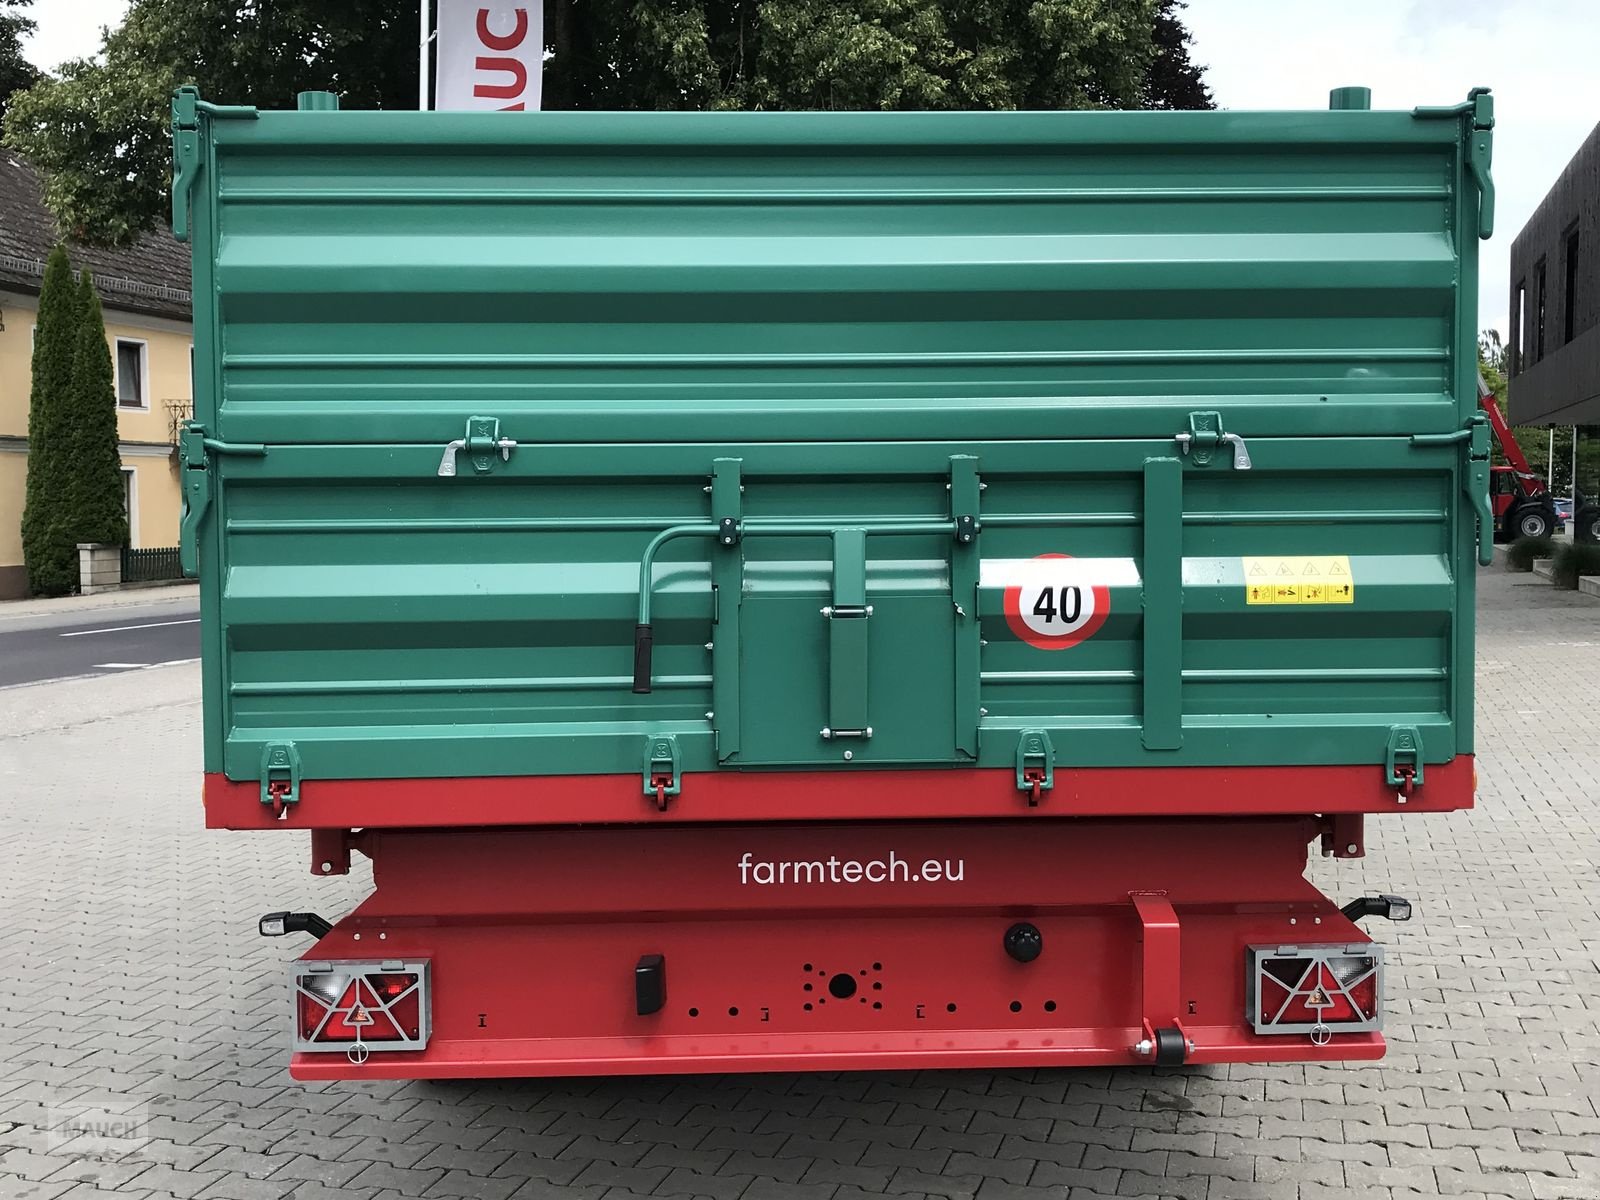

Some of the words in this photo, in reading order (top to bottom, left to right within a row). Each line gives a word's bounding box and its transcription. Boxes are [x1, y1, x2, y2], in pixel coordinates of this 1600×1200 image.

[473, 8, 528, 111] UC
[1033, 586, 1081, 623] 40
[738, 851, 964, 884] farmtech.eu
